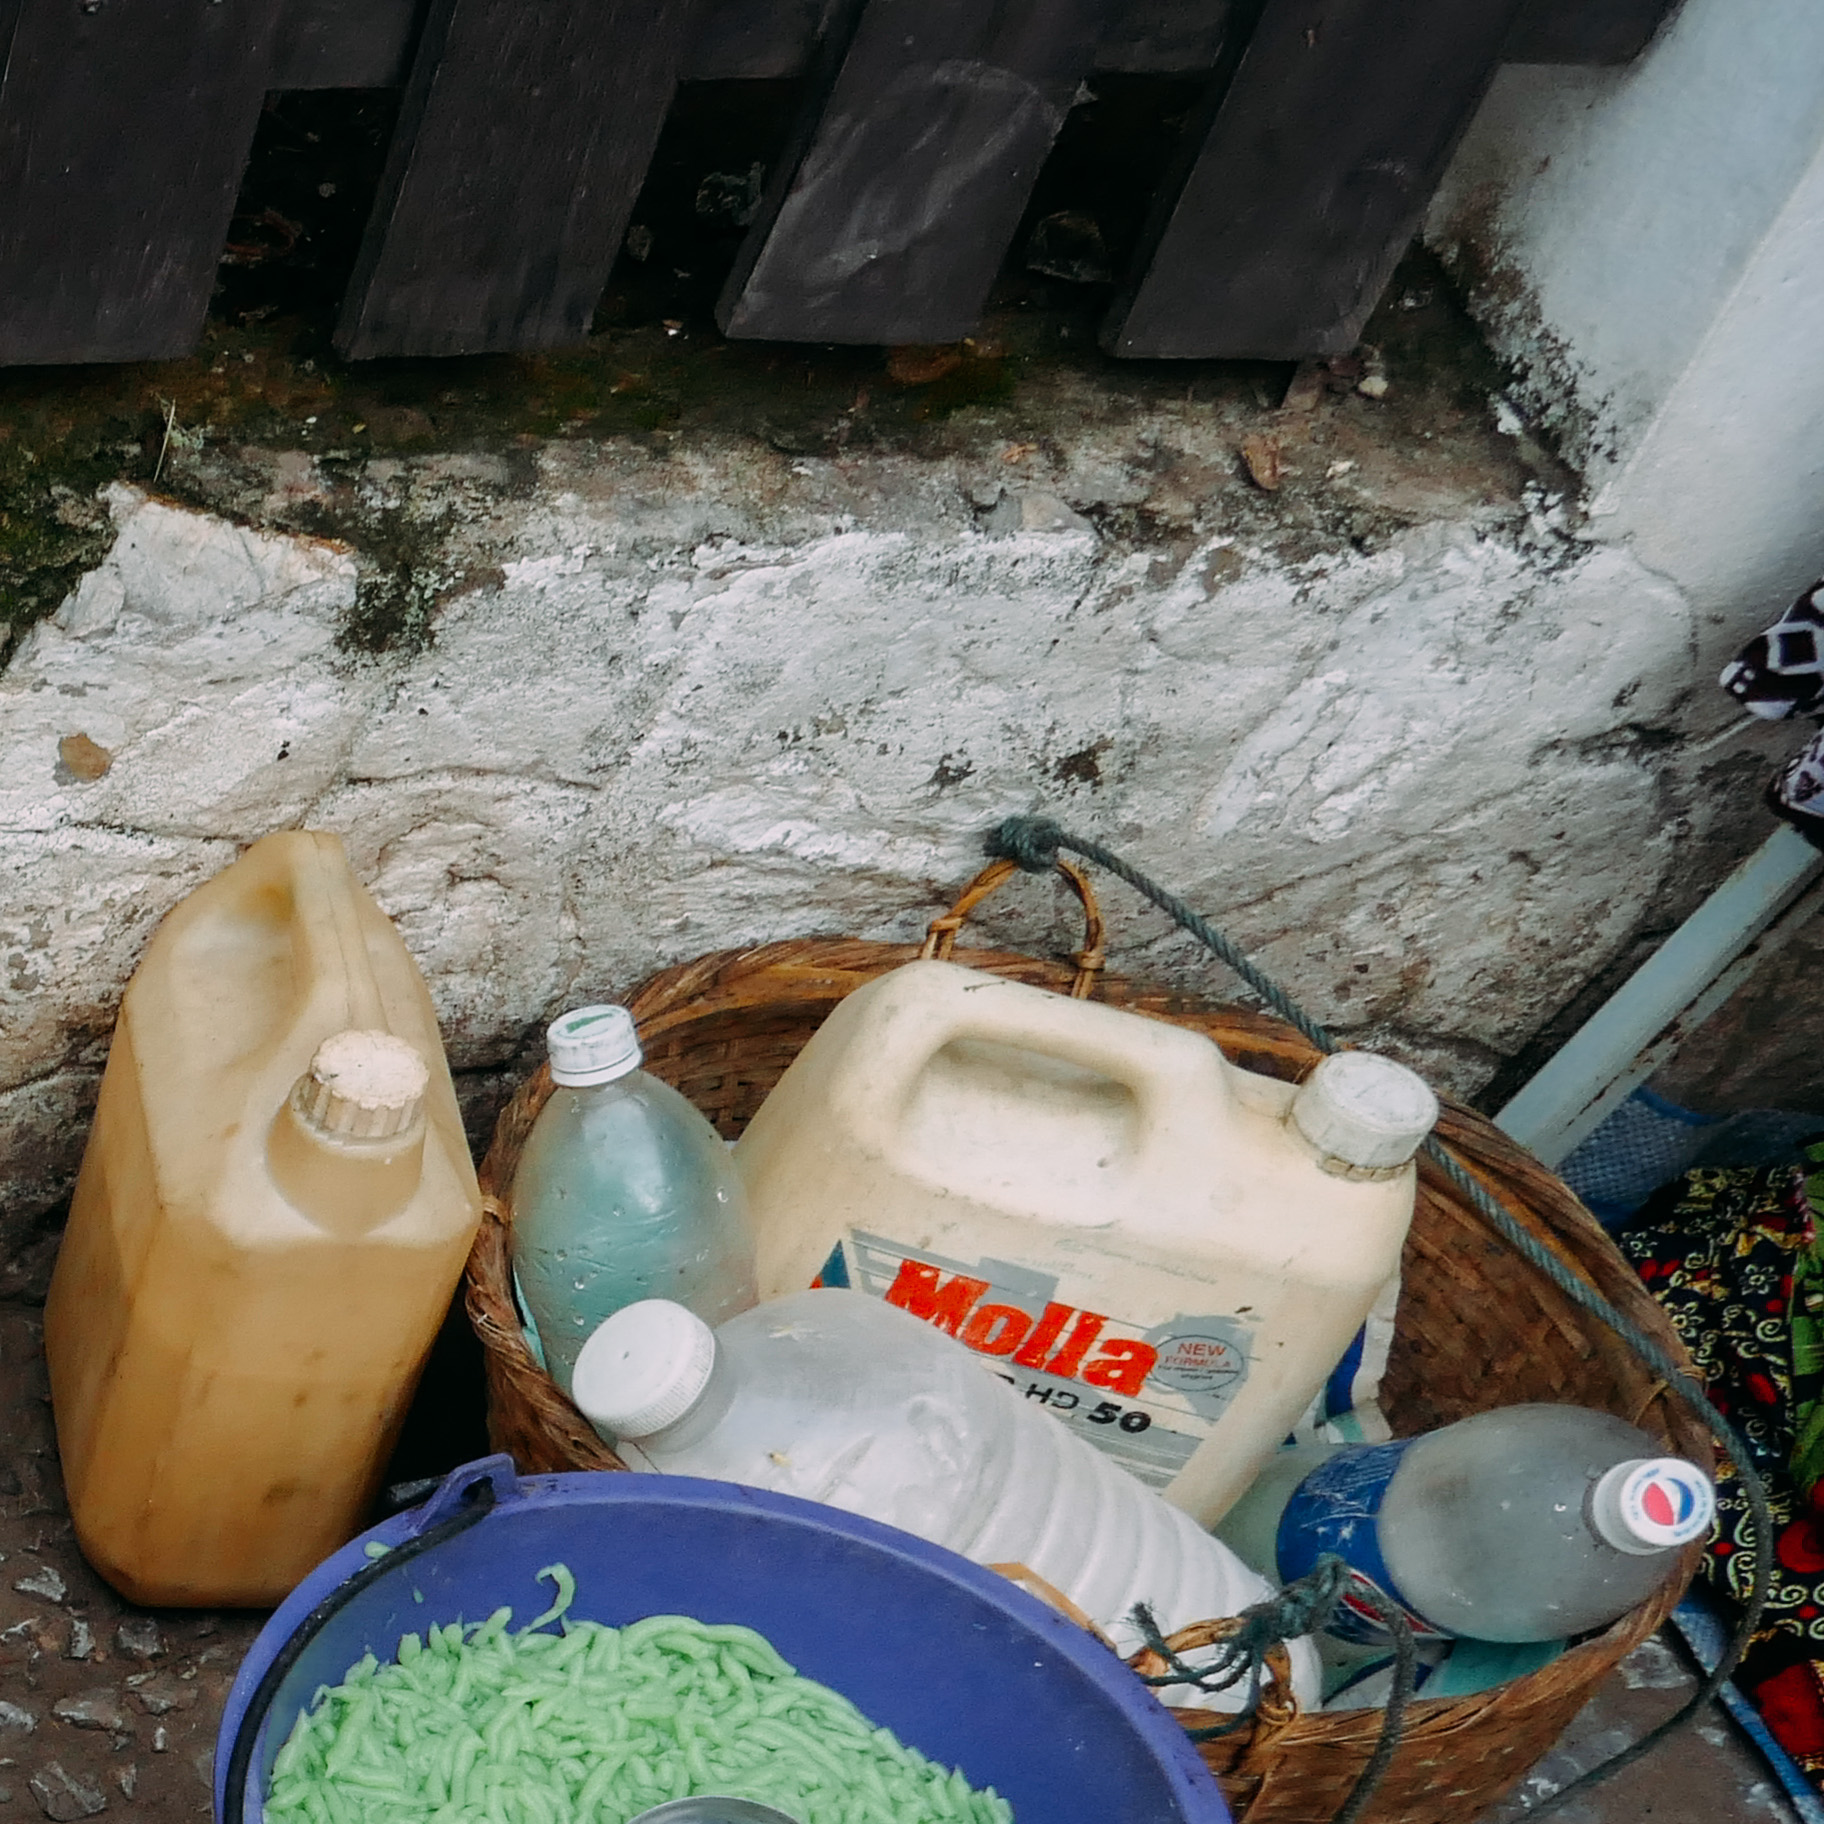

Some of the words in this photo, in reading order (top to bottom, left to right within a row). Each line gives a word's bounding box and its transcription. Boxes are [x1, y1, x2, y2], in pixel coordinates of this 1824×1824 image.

[885, 1259, 1159, 1398] Molla
[1177, 1342, 1227, 1356] NEW
[1087, 1402, 1152, 1434] 50
